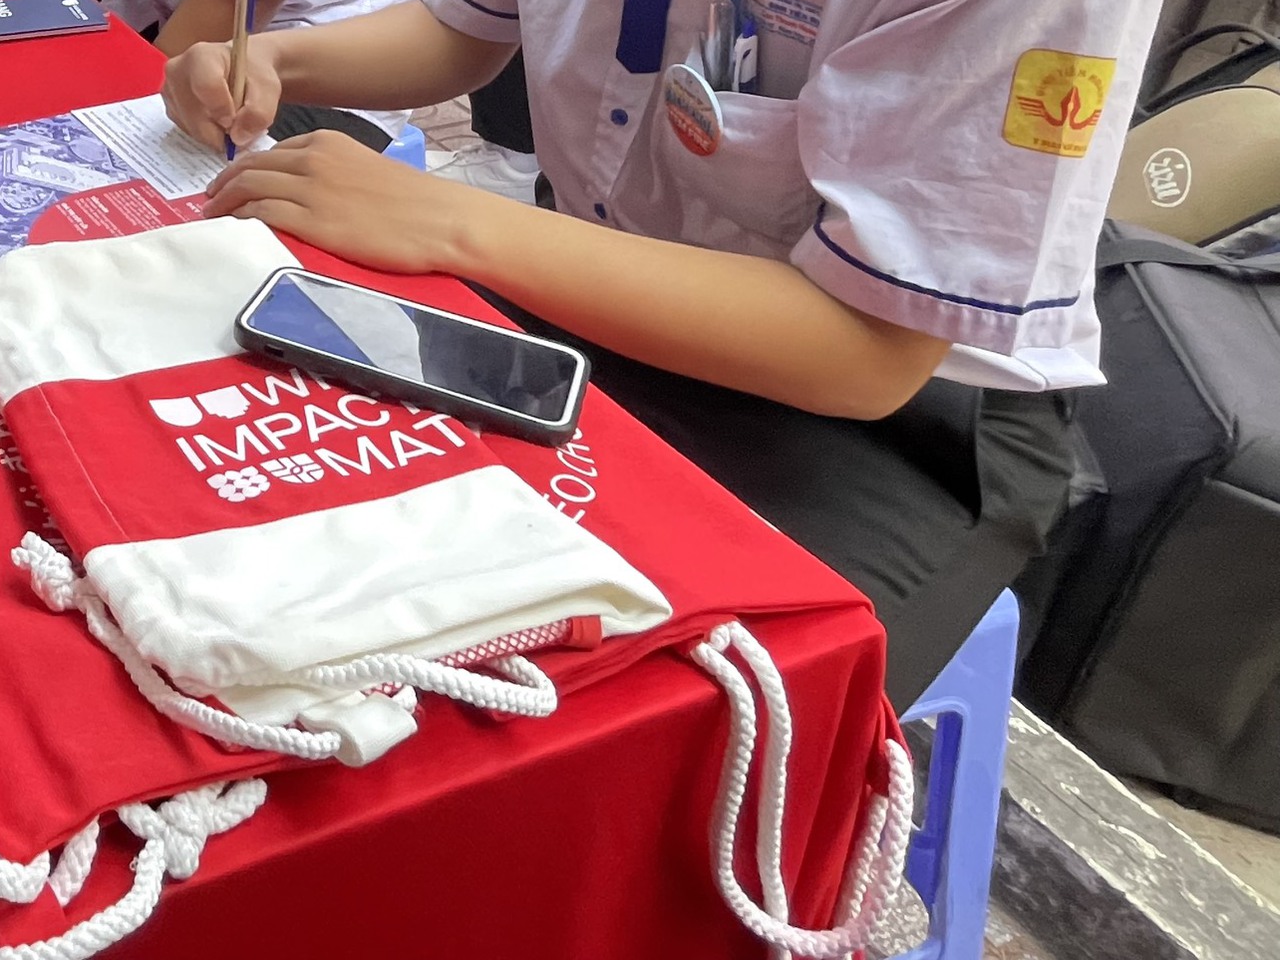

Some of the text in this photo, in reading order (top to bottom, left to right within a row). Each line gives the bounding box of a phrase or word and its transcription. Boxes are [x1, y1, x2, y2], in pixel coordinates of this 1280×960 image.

[241, 368, 331, 407] W
[175, 393, 420, 473] IMPAC
[314, 413, 468, 477] MAT
